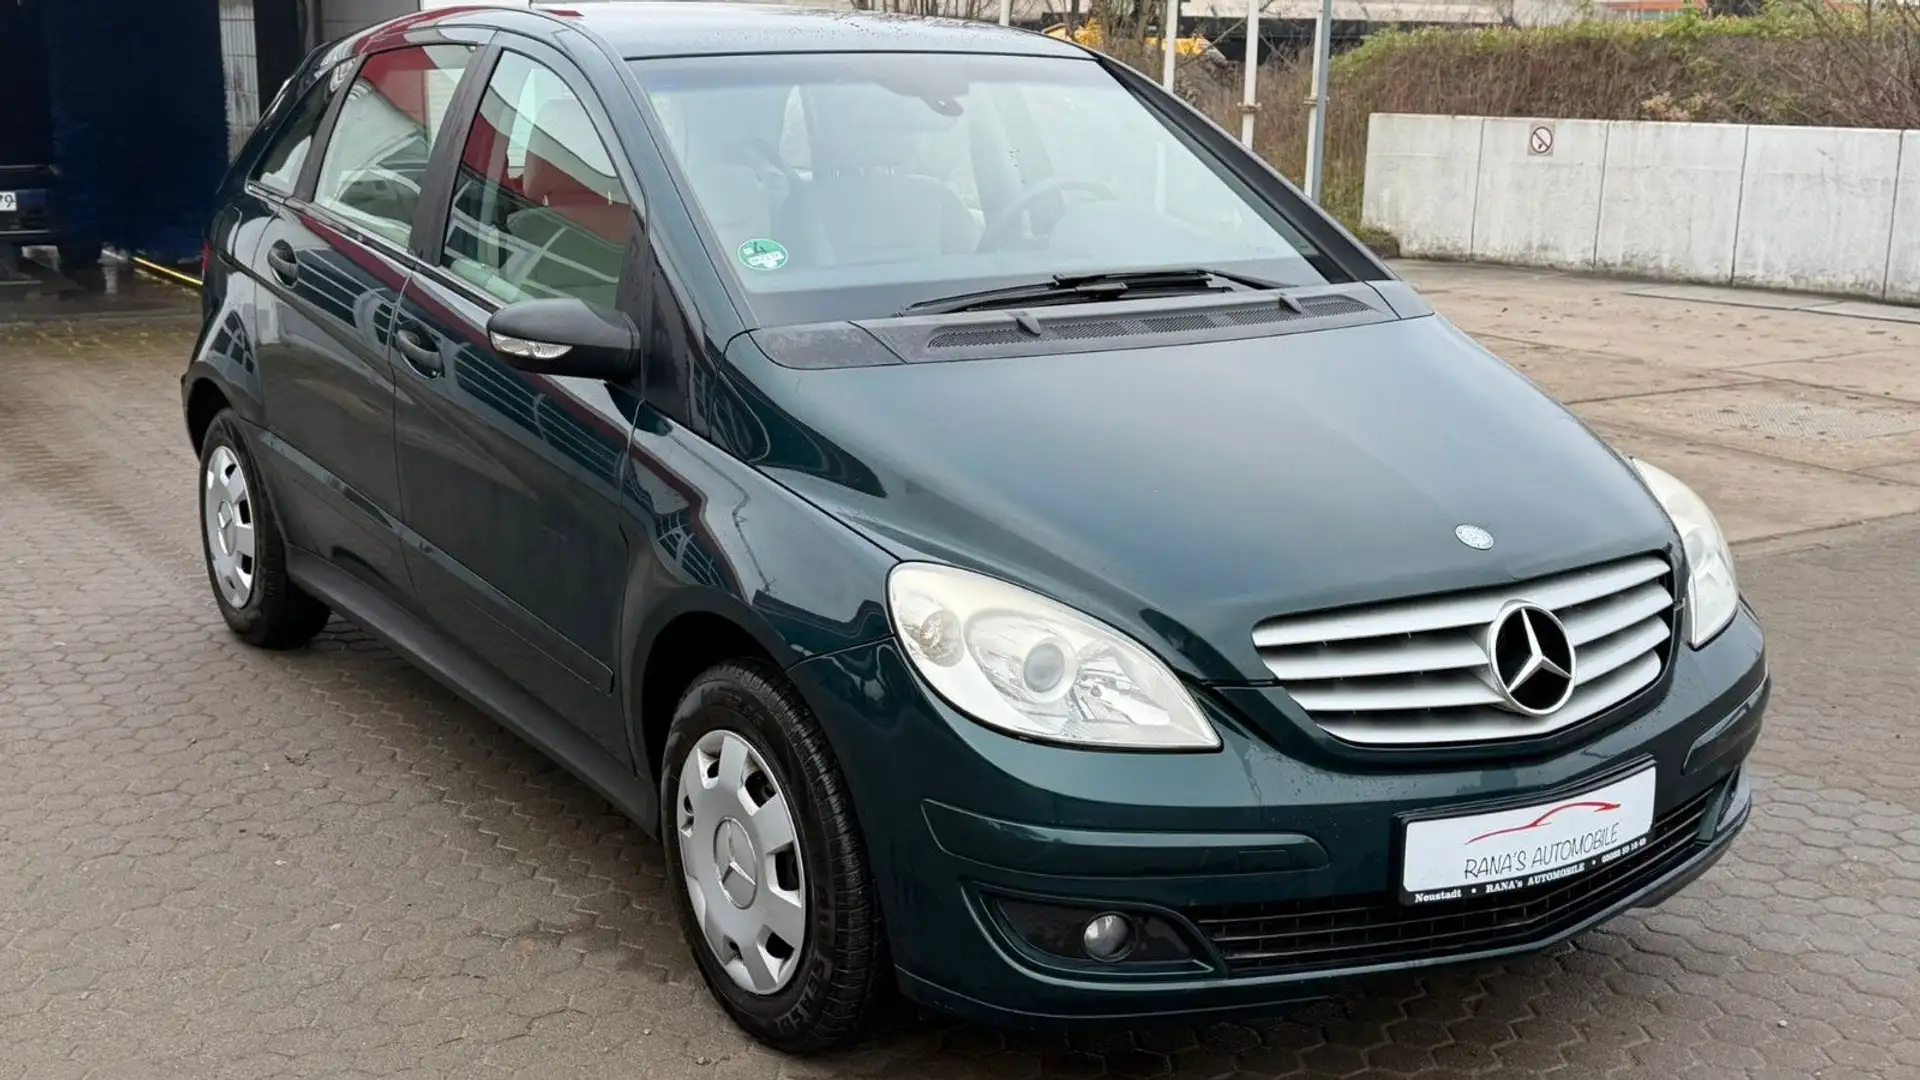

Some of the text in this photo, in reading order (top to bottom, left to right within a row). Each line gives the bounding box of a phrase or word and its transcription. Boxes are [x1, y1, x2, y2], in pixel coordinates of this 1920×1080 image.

[1464, 850, 1527, 879] RANA'S
[1531, 822, 1620, 868] AUTOMOBILE
[1414, 863, 1586, 903] Neustadt RANA's AUTOMOBILE
